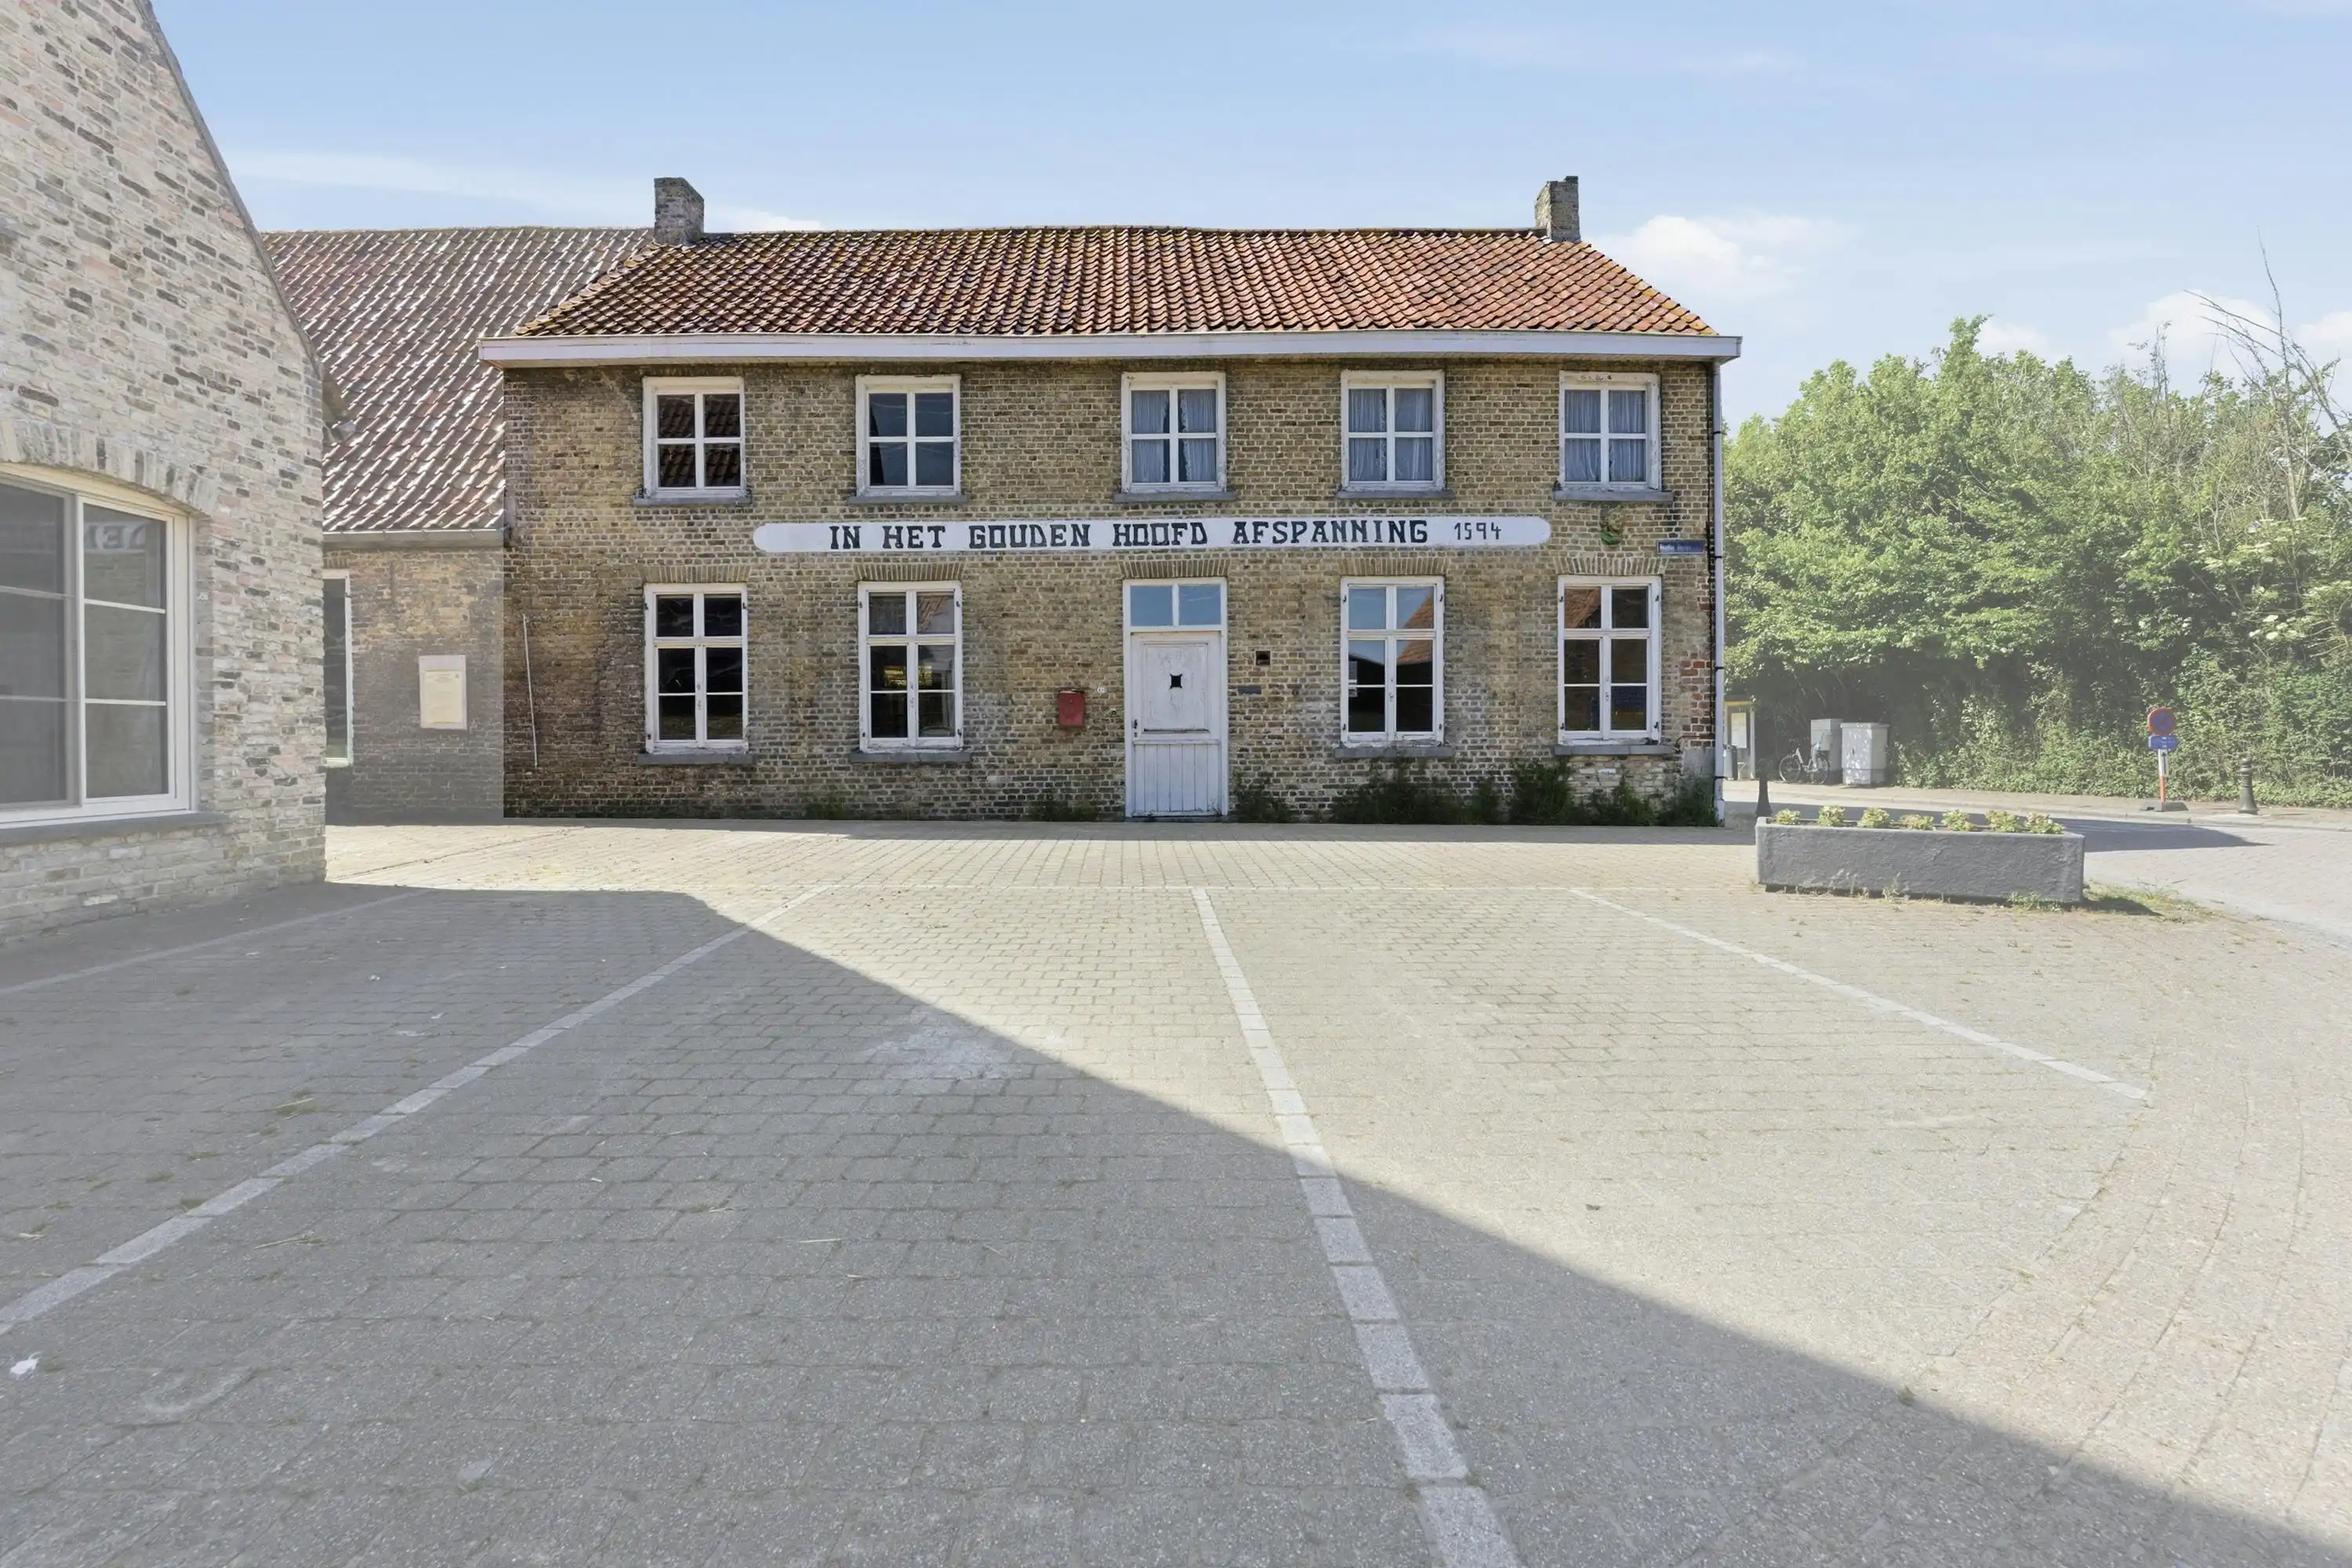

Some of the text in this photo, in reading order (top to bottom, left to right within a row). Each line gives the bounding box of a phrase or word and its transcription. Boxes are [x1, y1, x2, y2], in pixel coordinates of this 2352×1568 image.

[829, 520, 1502, 549] IN HET GOUDEN HOOFD AFSPANNING 1594
